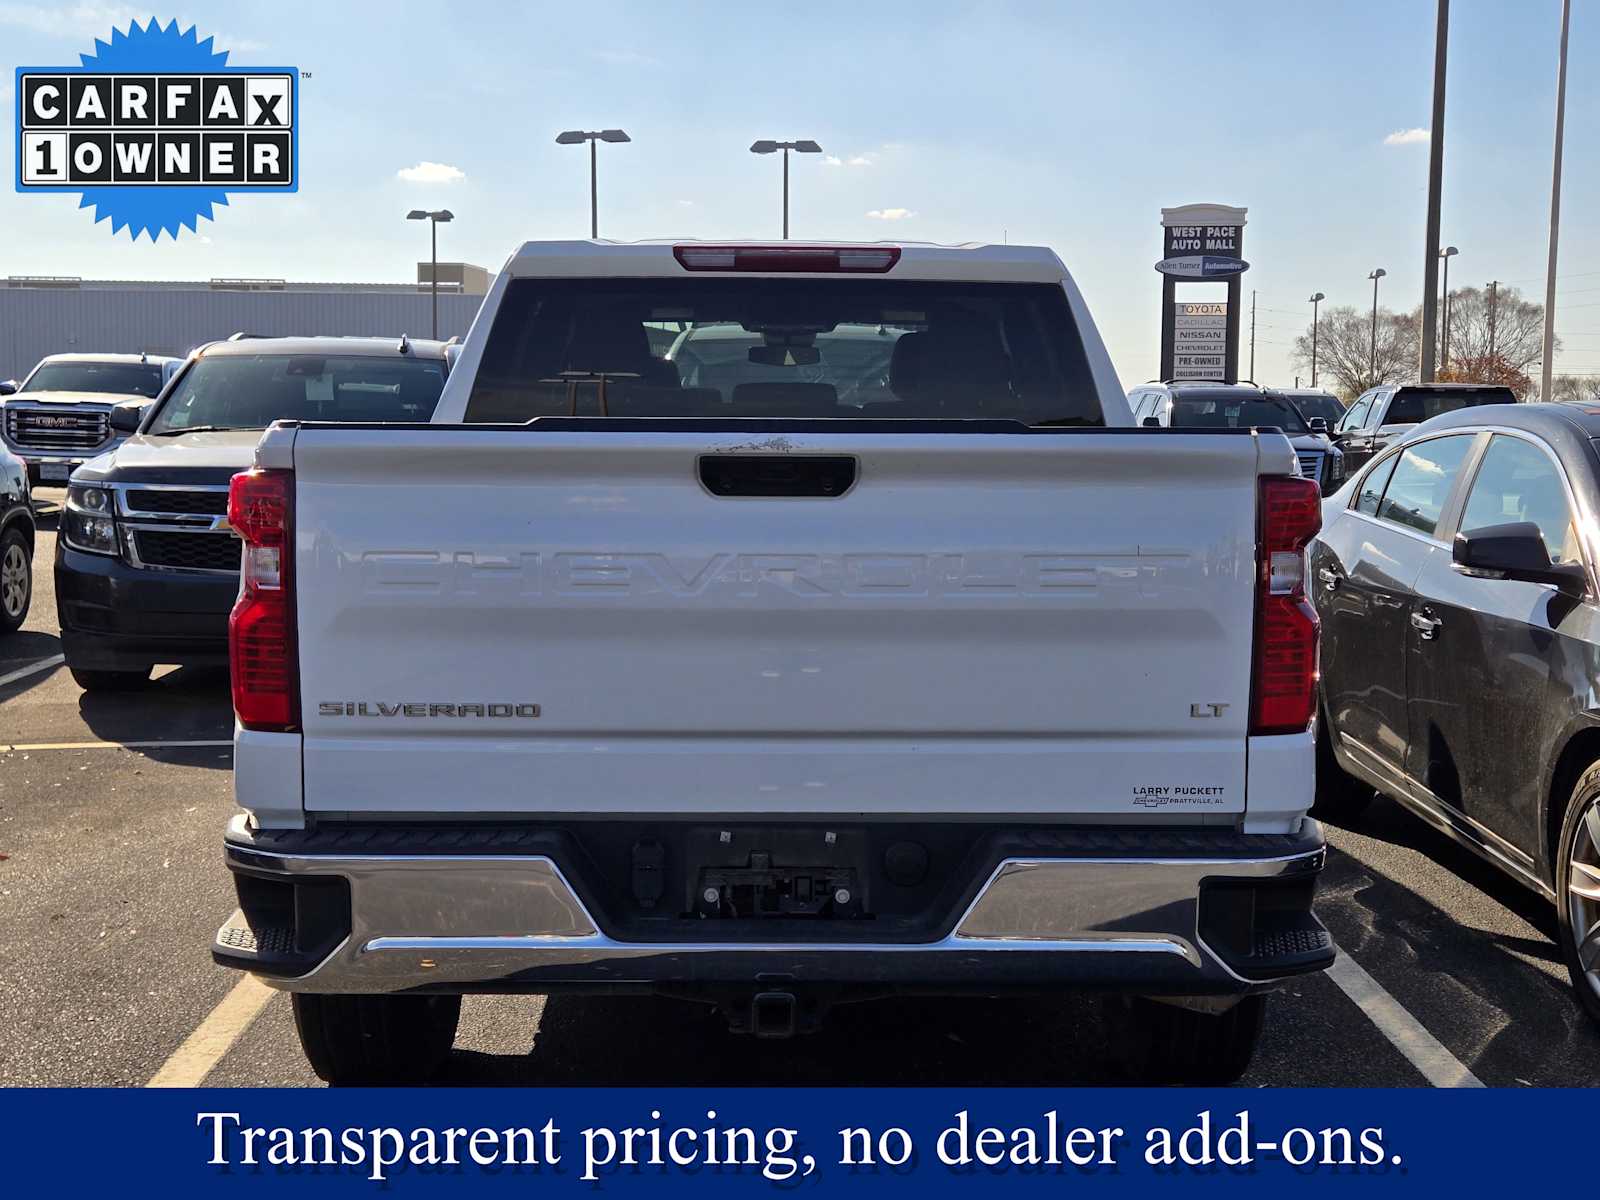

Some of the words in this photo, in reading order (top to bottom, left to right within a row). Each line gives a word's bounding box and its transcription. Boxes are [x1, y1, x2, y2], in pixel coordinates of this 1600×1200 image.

[1171, 227, 1201, 238] WEST
[1207, 227, 1235, 238] PACE
[1171, 239, 1201, 250] AUTO
[1206, 240, 1235, 250] MALL
[1180, 304, 1222, 314] TOYOTA
[1180, 331, 1221, 339] NISSAN
[1178, 356, 1221, 366] PRE-OWNED
[36, 416, 77, 428] GMC
[361, 550, 1190, 598] CHEVROLET
[319, 702, 541, 718] SILVERADO
[1190, 703, 1230, 718] LT
[1133, 787, 1170, 795] LARRY
[1175, 787, 1224, 795] PUCKETT
